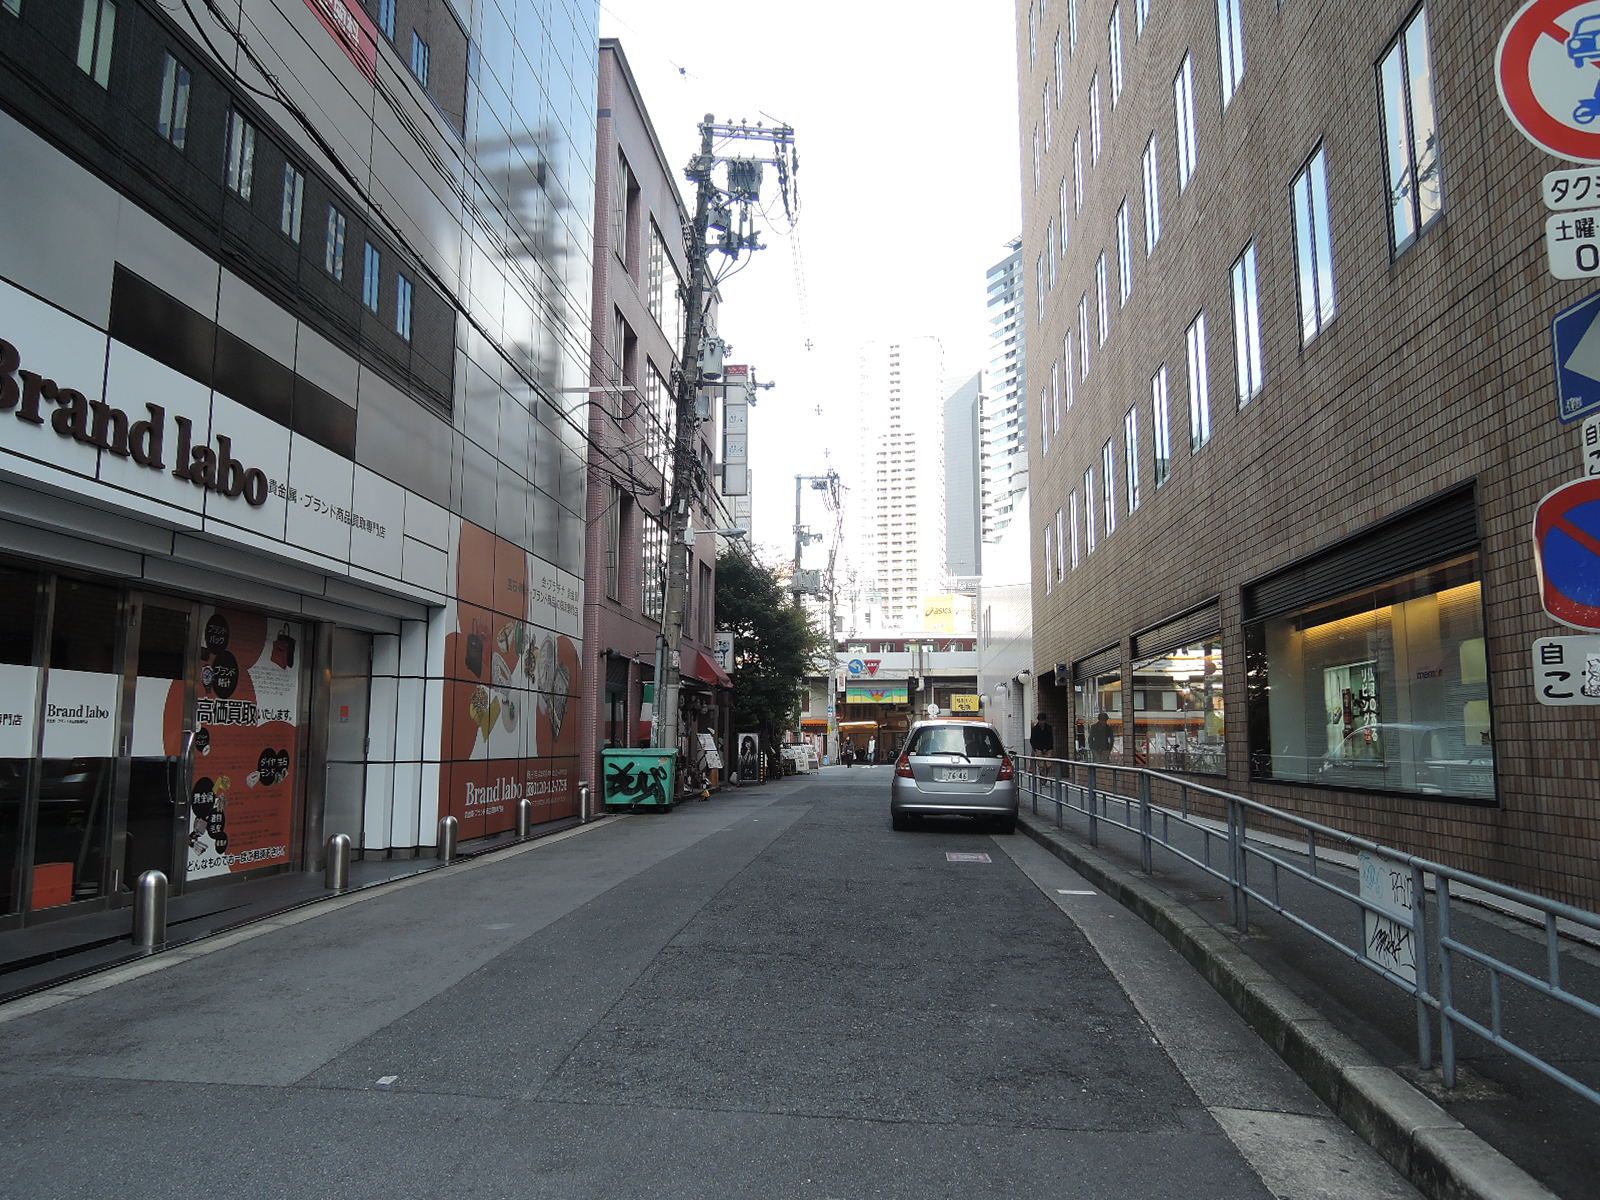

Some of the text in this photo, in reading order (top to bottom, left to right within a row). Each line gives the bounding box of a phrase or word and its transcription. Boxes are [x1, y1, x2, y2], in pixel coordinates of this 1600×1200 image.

[1551, 175, 1600, 203] タク
[1586, 423, 1600, 446] 自
[172, 415, 269, 506] labo
[1541, 643, 1563, 665] 自
[1543, 671, 1600, 698] こ
[47, 704, 109, 719] Brand labo
[465, 778, 500, 806] Brand
[501, 776, 522, 800] labo
